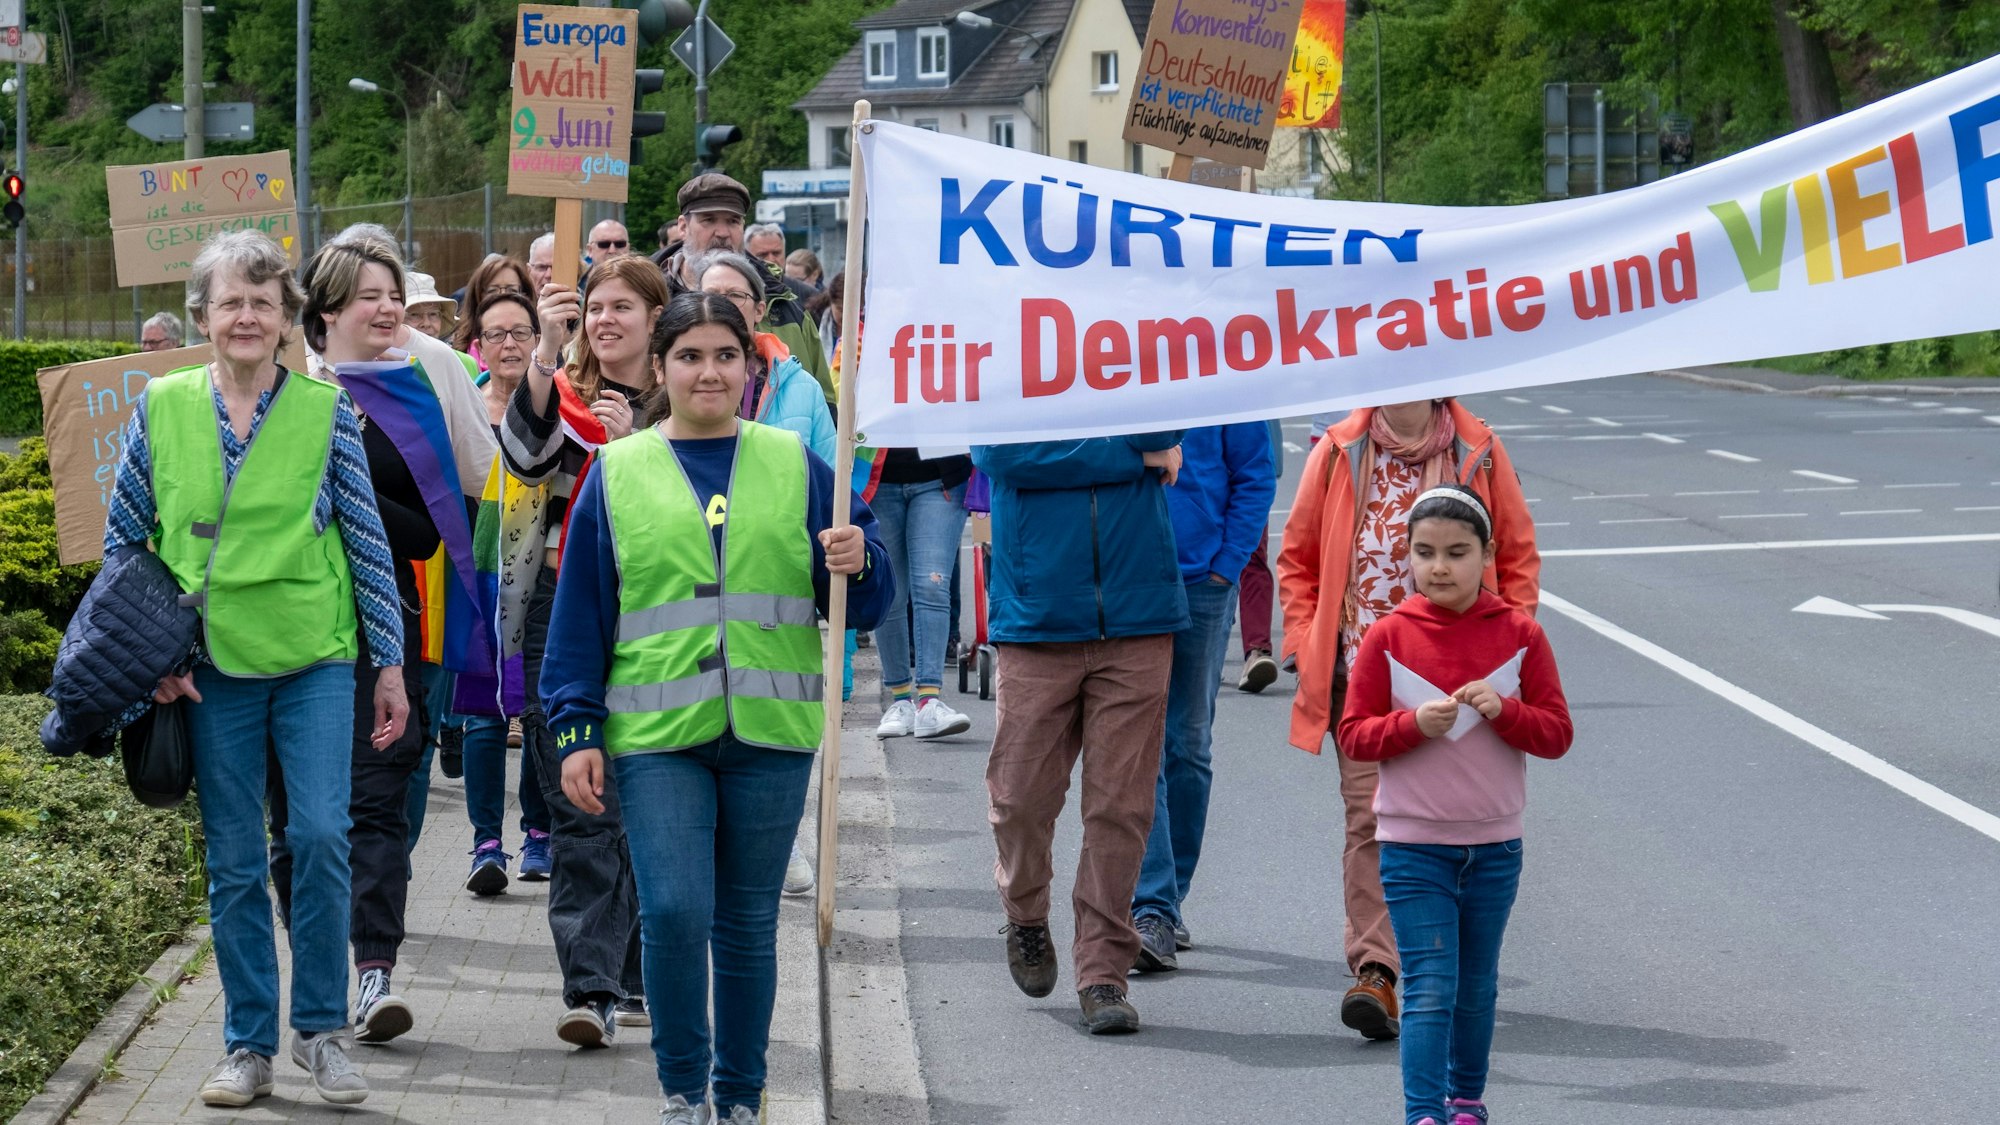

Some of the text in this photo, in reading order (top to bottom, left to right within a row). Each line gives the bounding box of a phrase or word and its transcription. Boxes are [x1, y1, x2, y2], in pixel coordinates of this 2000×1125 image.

[523, 12, 626, 64] Europa
[519, 56, 607, 100] Wahl
[1146, 38, 1282, 104] Deutschland
[1139, 75, 1264, 126] ist verpflichtet
[513, 106, 615, 149] 9. Juni
[1199, 120, 1270, 155] aufzunehmen
[139, 165, 203, 196] BUNT
[147, 200, 206, 220] ist die
[939, 175, 1423, 268] KÜRTEN
[889, 231, 1698, 404] für Demokratie und
